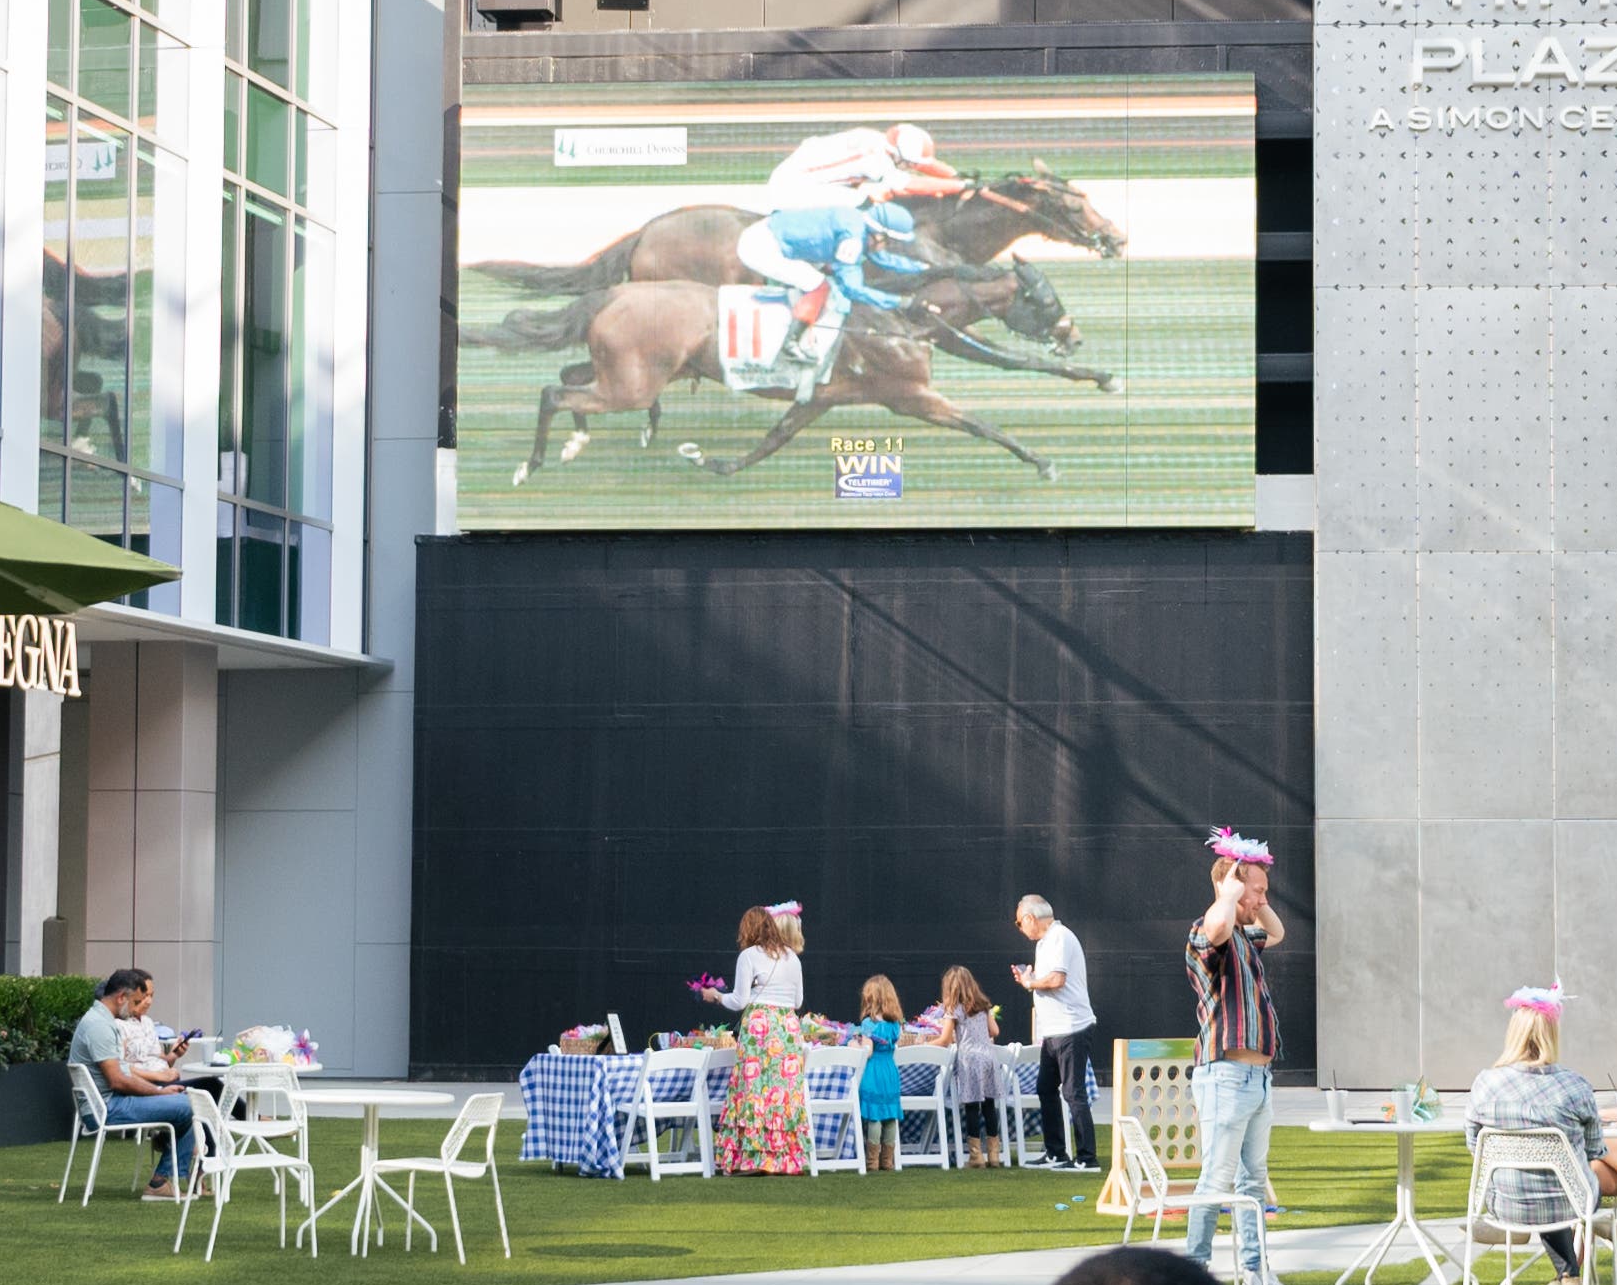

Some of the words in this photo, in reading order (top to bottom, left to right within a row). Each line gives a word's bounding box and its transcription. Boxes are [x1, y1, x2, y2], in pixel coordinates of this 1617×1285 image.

[1368, 106, 1396, 131] A
[1407, 106, 1544, 131] SIMON
[831, 437, 876, 452] Race
[885, 437, 904, 452] 11
[836, 455, 902, 475] WIN
